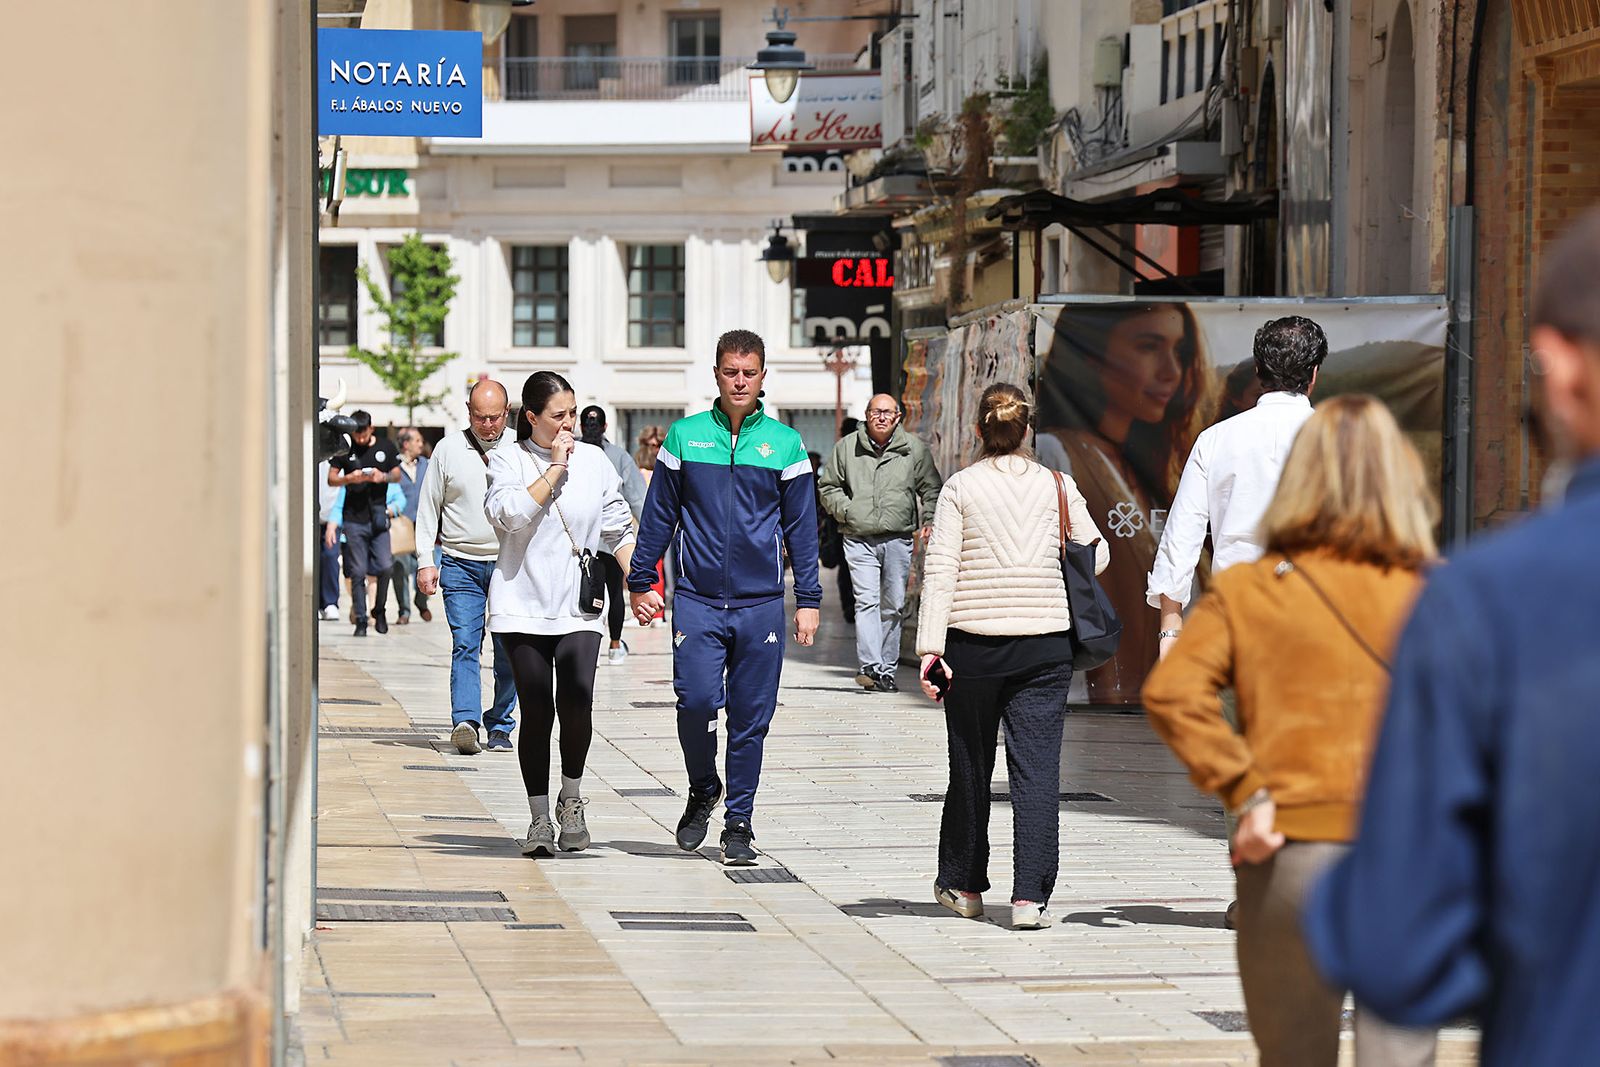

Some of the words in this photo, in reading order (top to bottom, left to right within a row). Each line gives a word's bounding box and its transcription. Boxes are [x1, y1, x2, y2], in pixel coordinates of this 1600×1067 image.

[330, 56, 467, 86] NOTARÍA
[351, 96, 403, 112] ÁBALOS
[411, 100, 463, 114] NUEVO
[832, 258, 895, 287] CAL
